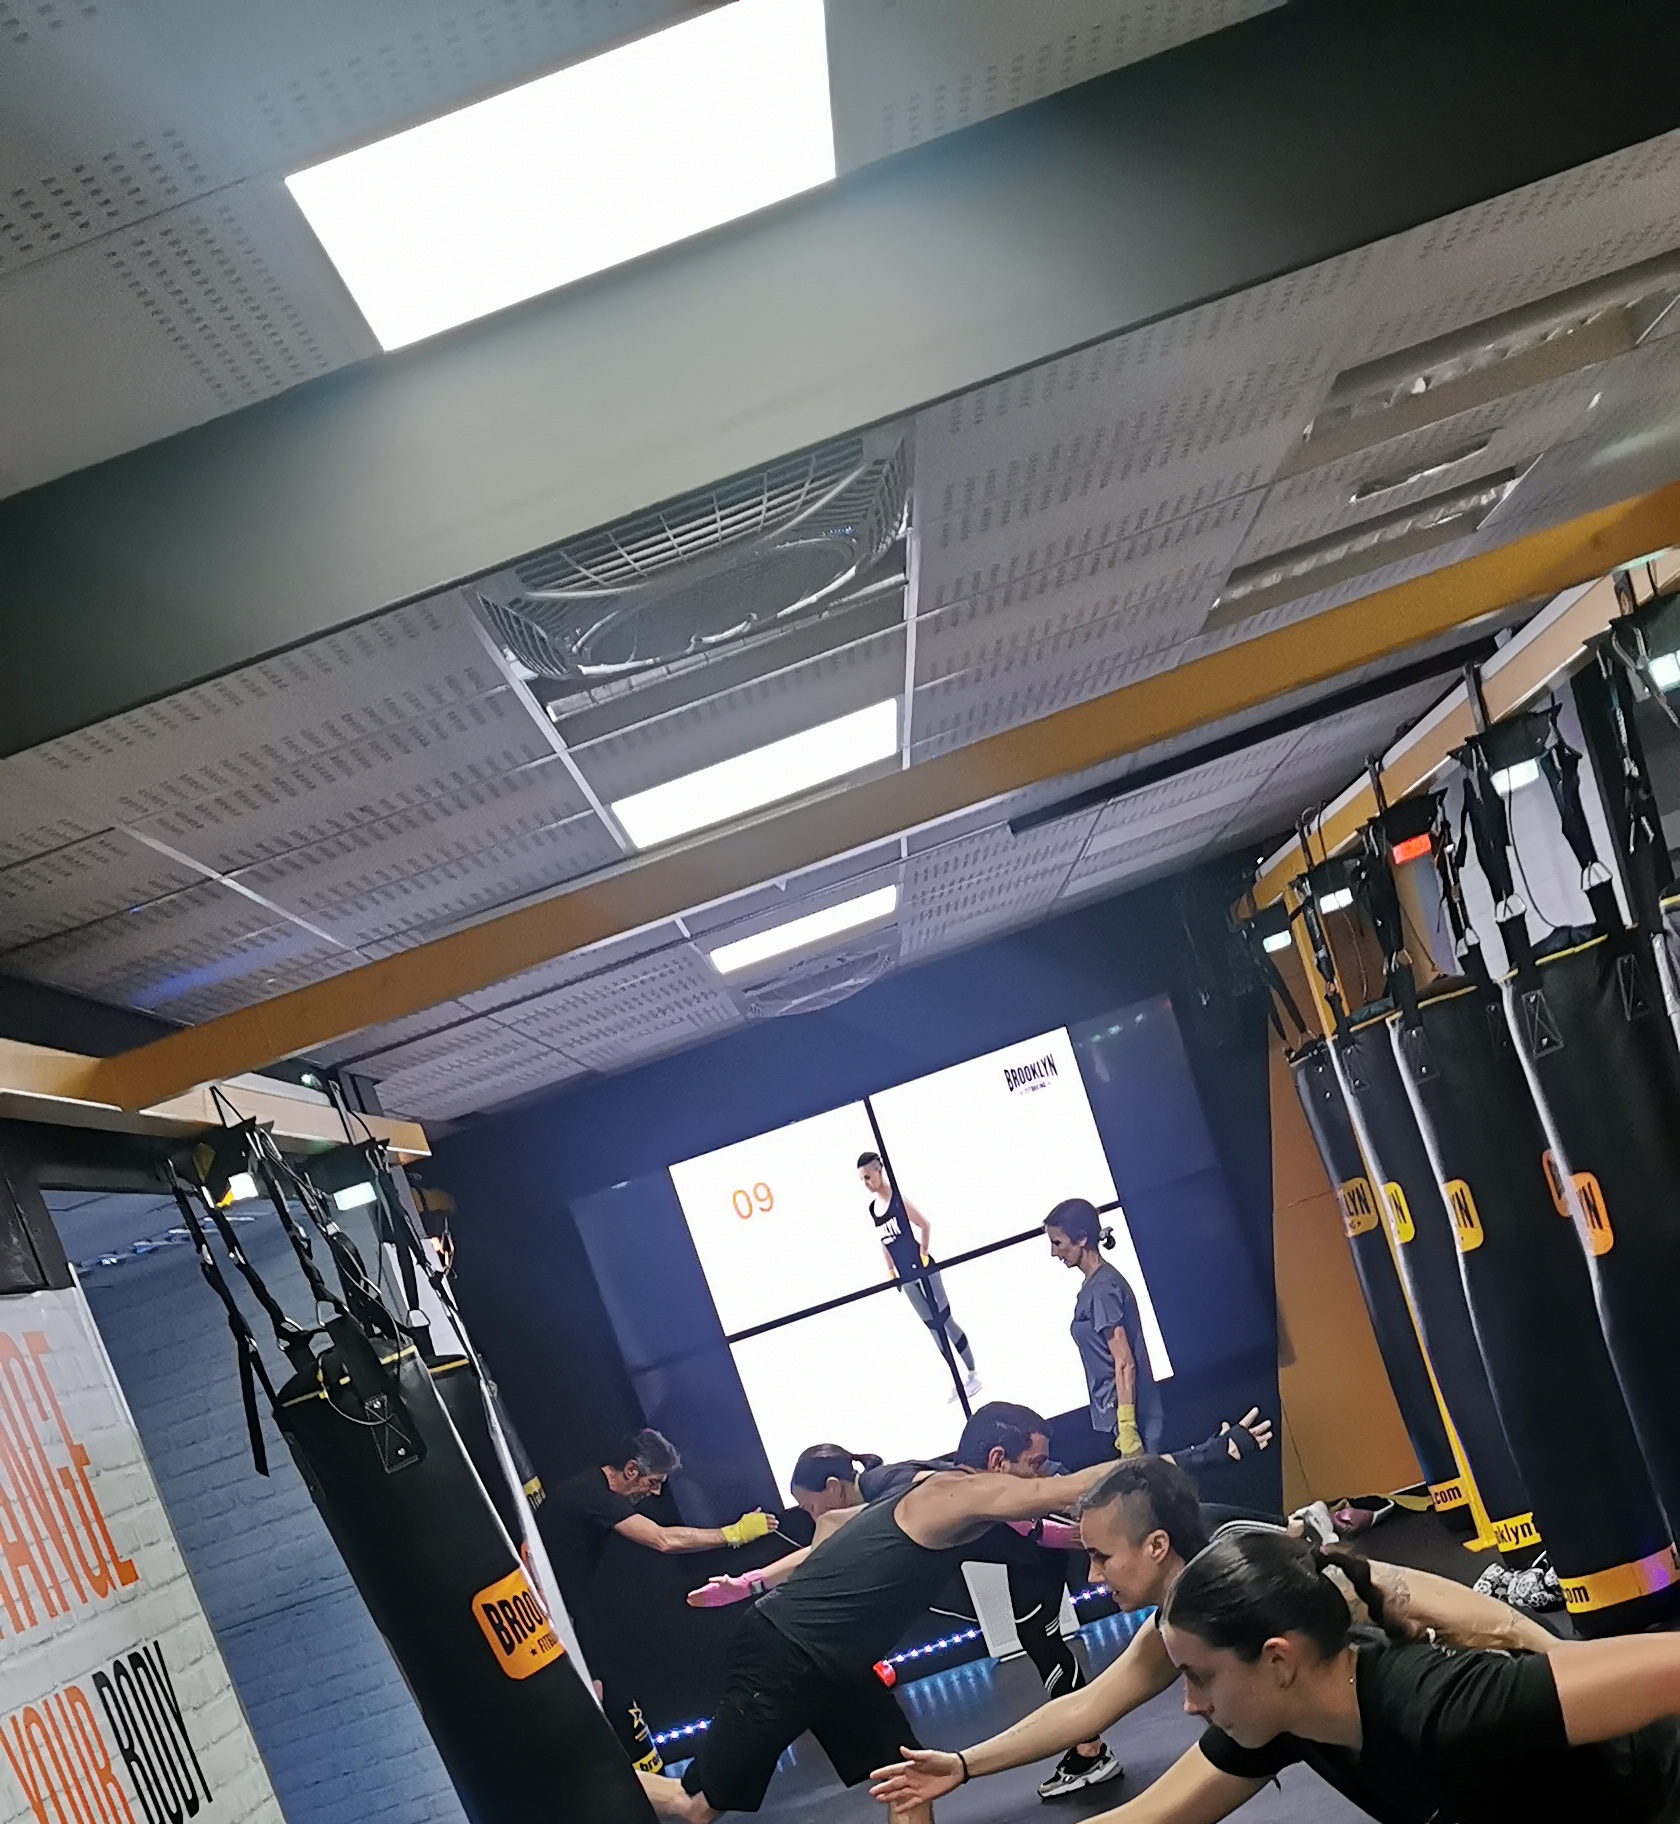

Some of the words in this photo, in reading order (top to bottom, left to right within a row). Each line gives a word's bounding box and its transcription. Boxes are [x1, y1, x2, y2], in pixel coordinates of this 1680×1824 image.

[1003, 1053, 1059, 1093] BROOKLYN
[732, 1182, 774, 1220] 09
[0, 1330, 139, 1640] ANGE
[481, 1588, 546, 1657] BROO
